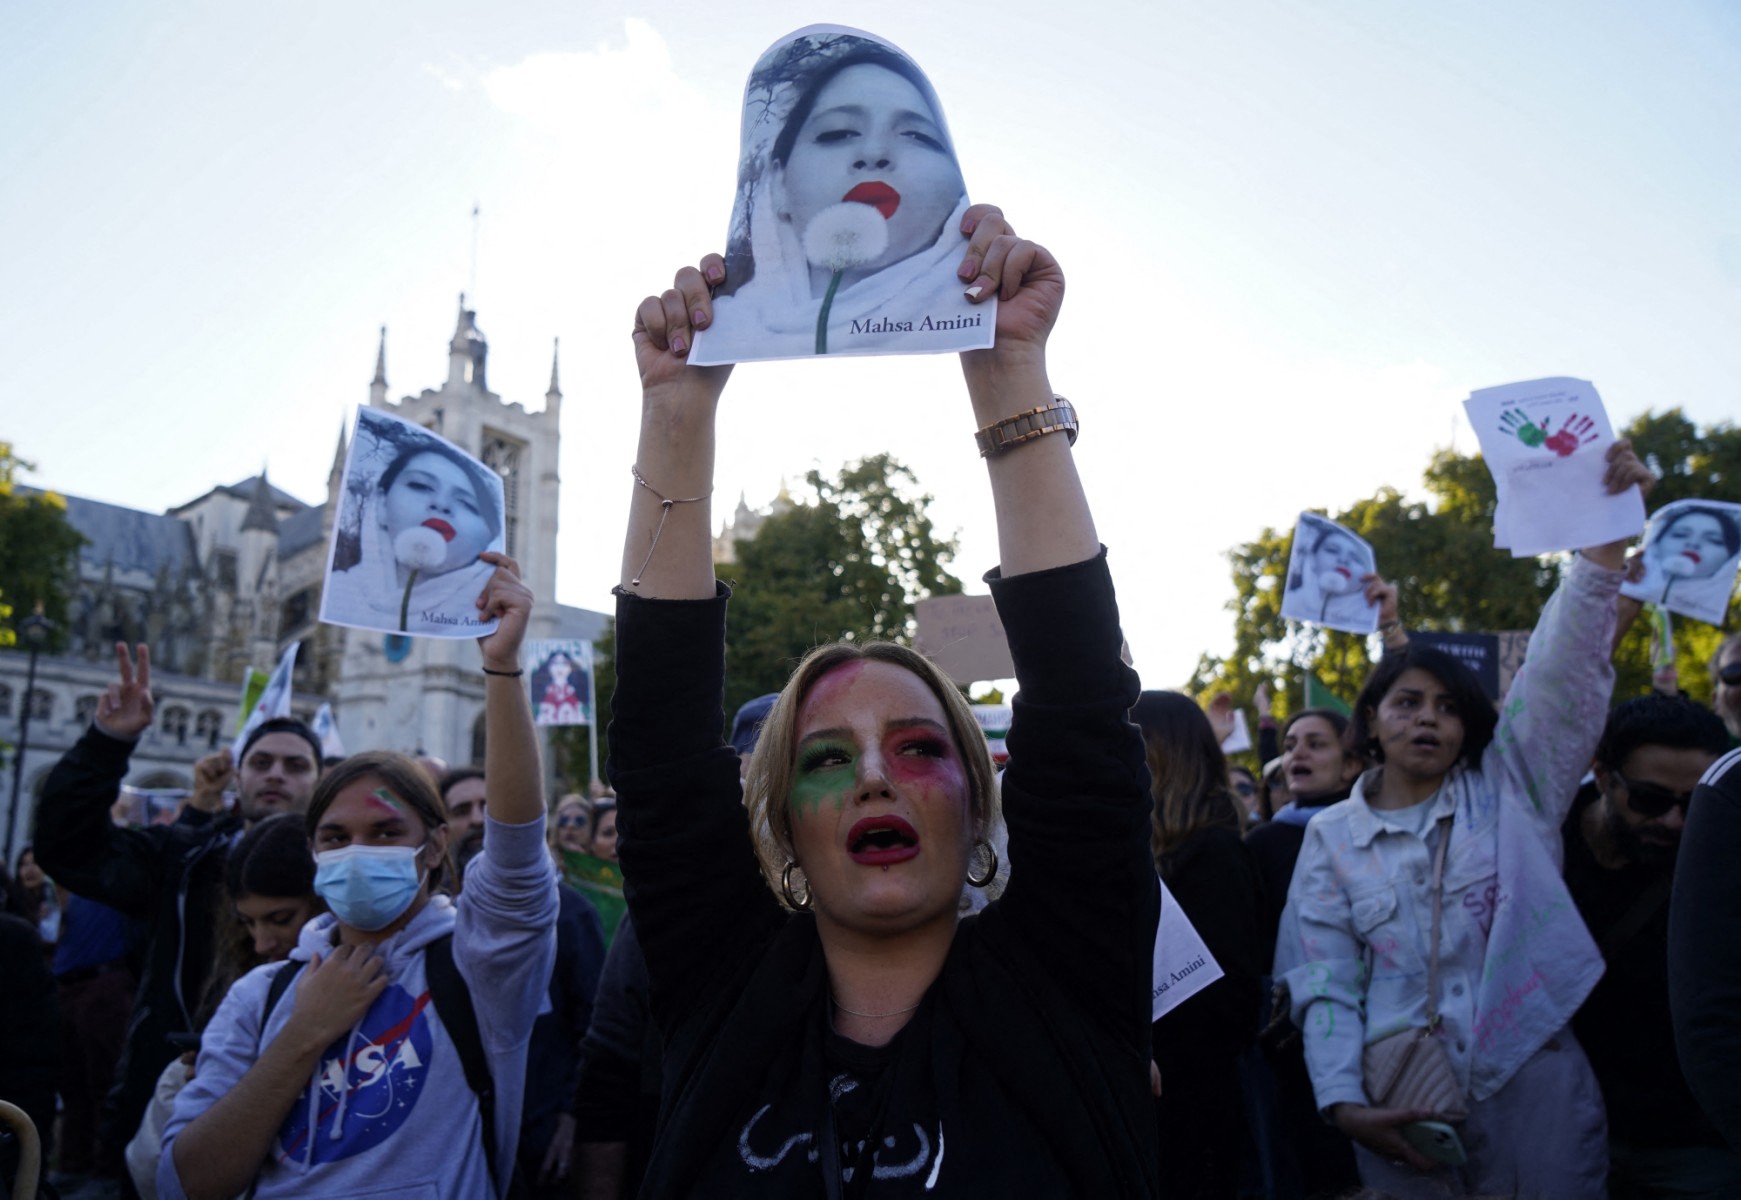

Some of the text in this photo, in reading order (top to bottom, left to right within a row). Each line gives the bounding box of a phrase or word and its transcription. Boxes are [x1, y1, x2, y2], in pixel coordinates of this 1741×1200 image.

[849, 313, 982, 335] Mahsa Amini
[421, 610, 495, 627] Mahsa Ami
[1170, 954, 1206, 985] Amini
[303, 1036, 423, 1098] ASA
